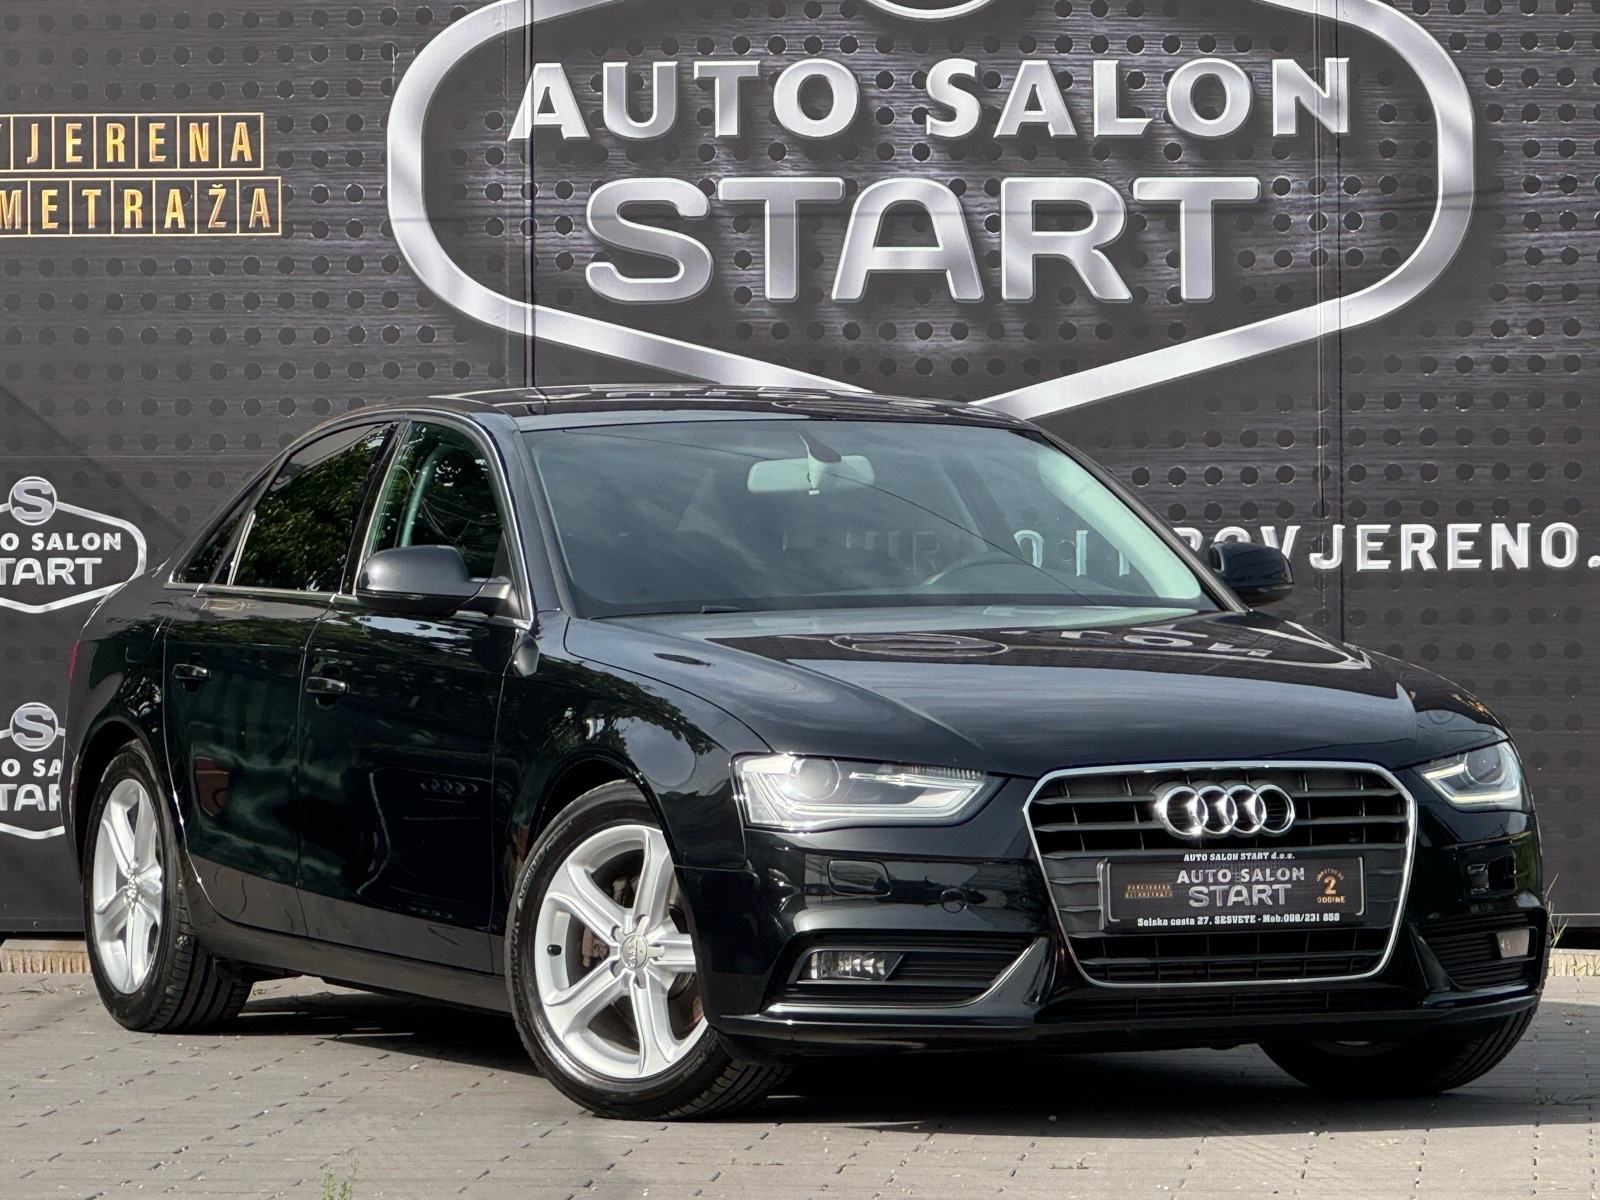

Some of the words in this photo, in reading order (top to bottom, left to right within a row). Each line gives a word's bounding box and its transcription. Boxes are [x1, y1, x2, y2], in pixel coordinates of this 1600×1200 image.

[507, 60, 860, 141] AUTO
[923, 57, 1352, 139] SALON
[0, 122, 252, 165] JERENA
[0, 184, 271, 230] METRAŽA
[585, 176, 1261, 304] START
[13, 481, 53, 521] S
[0, 532, 20, 551] O
[31, 532, 121, 551] SALON
[14, 707, 54, 747] S
[1, 758, 21, 777] O
[1183, 853, 1208, 862] AUTO
[1209, 852, 1239, 861] SALON
[1240, 851, 1270, 861] START
[1176, 868, 1232, 884] AUTO
[1240, 867, 1305, 882] SALON
[1323, 875, 1337, 895] 2
[1188, 883, 1292, 908] START
